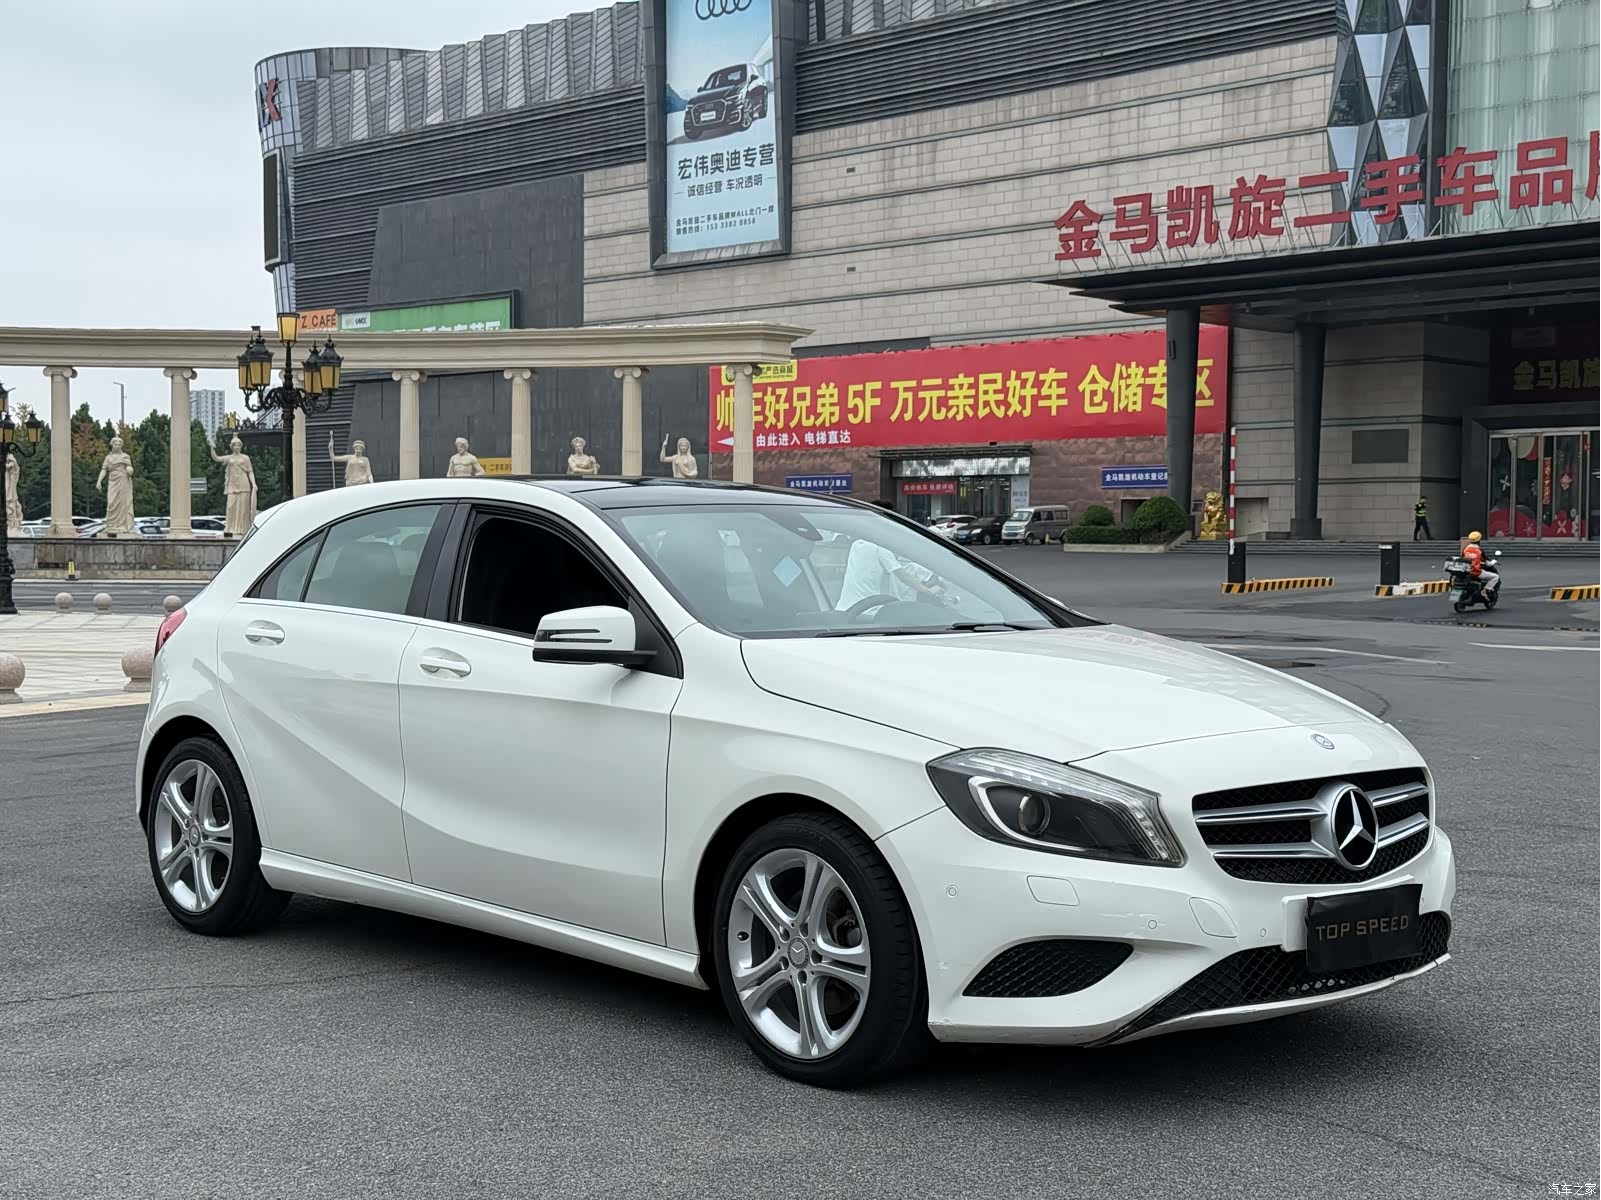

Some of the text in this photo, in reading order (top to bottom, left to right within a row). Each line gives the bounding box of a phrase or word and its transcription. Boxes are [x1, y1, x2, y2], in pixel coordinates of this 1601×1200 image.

[677, 143, 774, 180] 宏伟奥迪专营
[687, 174, 763, 197] 诚信经营 车况透明
[1055, 130, 1600, 261] 金马凯旋二手车品
[847, 381, 882, 425] 5F
[890, 367, 1069, 423] 万元亲民好车
[756, 430, 851, 448] 由此进入 电梯直达
[1315, 915, 1409, 941] TOP SPEED
